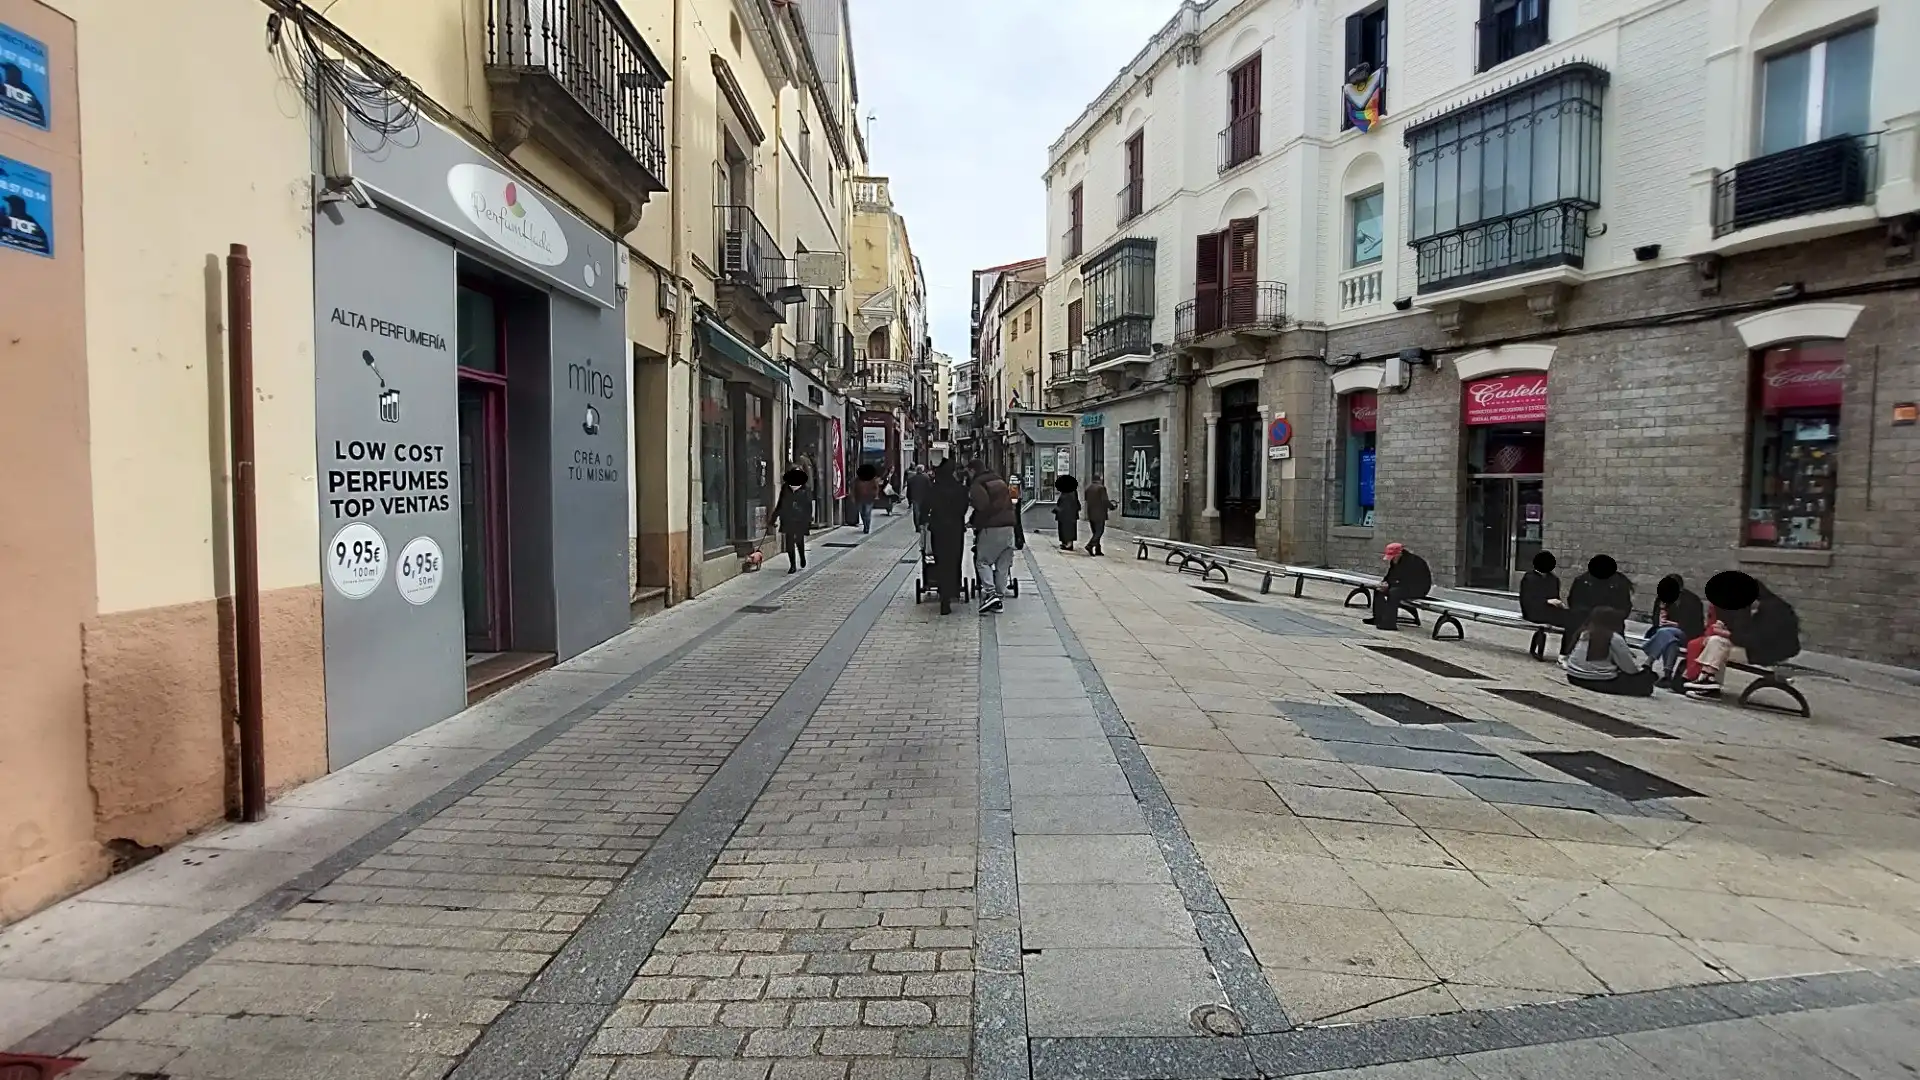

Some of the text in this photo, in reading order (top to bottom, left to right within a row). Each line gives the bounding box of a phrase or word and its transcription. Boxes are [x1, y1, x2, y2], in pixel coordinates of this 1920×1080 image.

[331, 307, 447, 352] ALTA PERFUMERÍA
[568, 358, 614, 399] mine
[1469, 379, 1548, 407] Castela
[335, 440, 444, 463] LOW COST
[329, 470, 449, 493] PERFUMES
[330, 495, 450, 518] TOP VENTAS
[336, 540, 381, 569] 9,95€
[402, 552, 439, 579] 6,95€
[353, 565, 378, 577] 100ml
